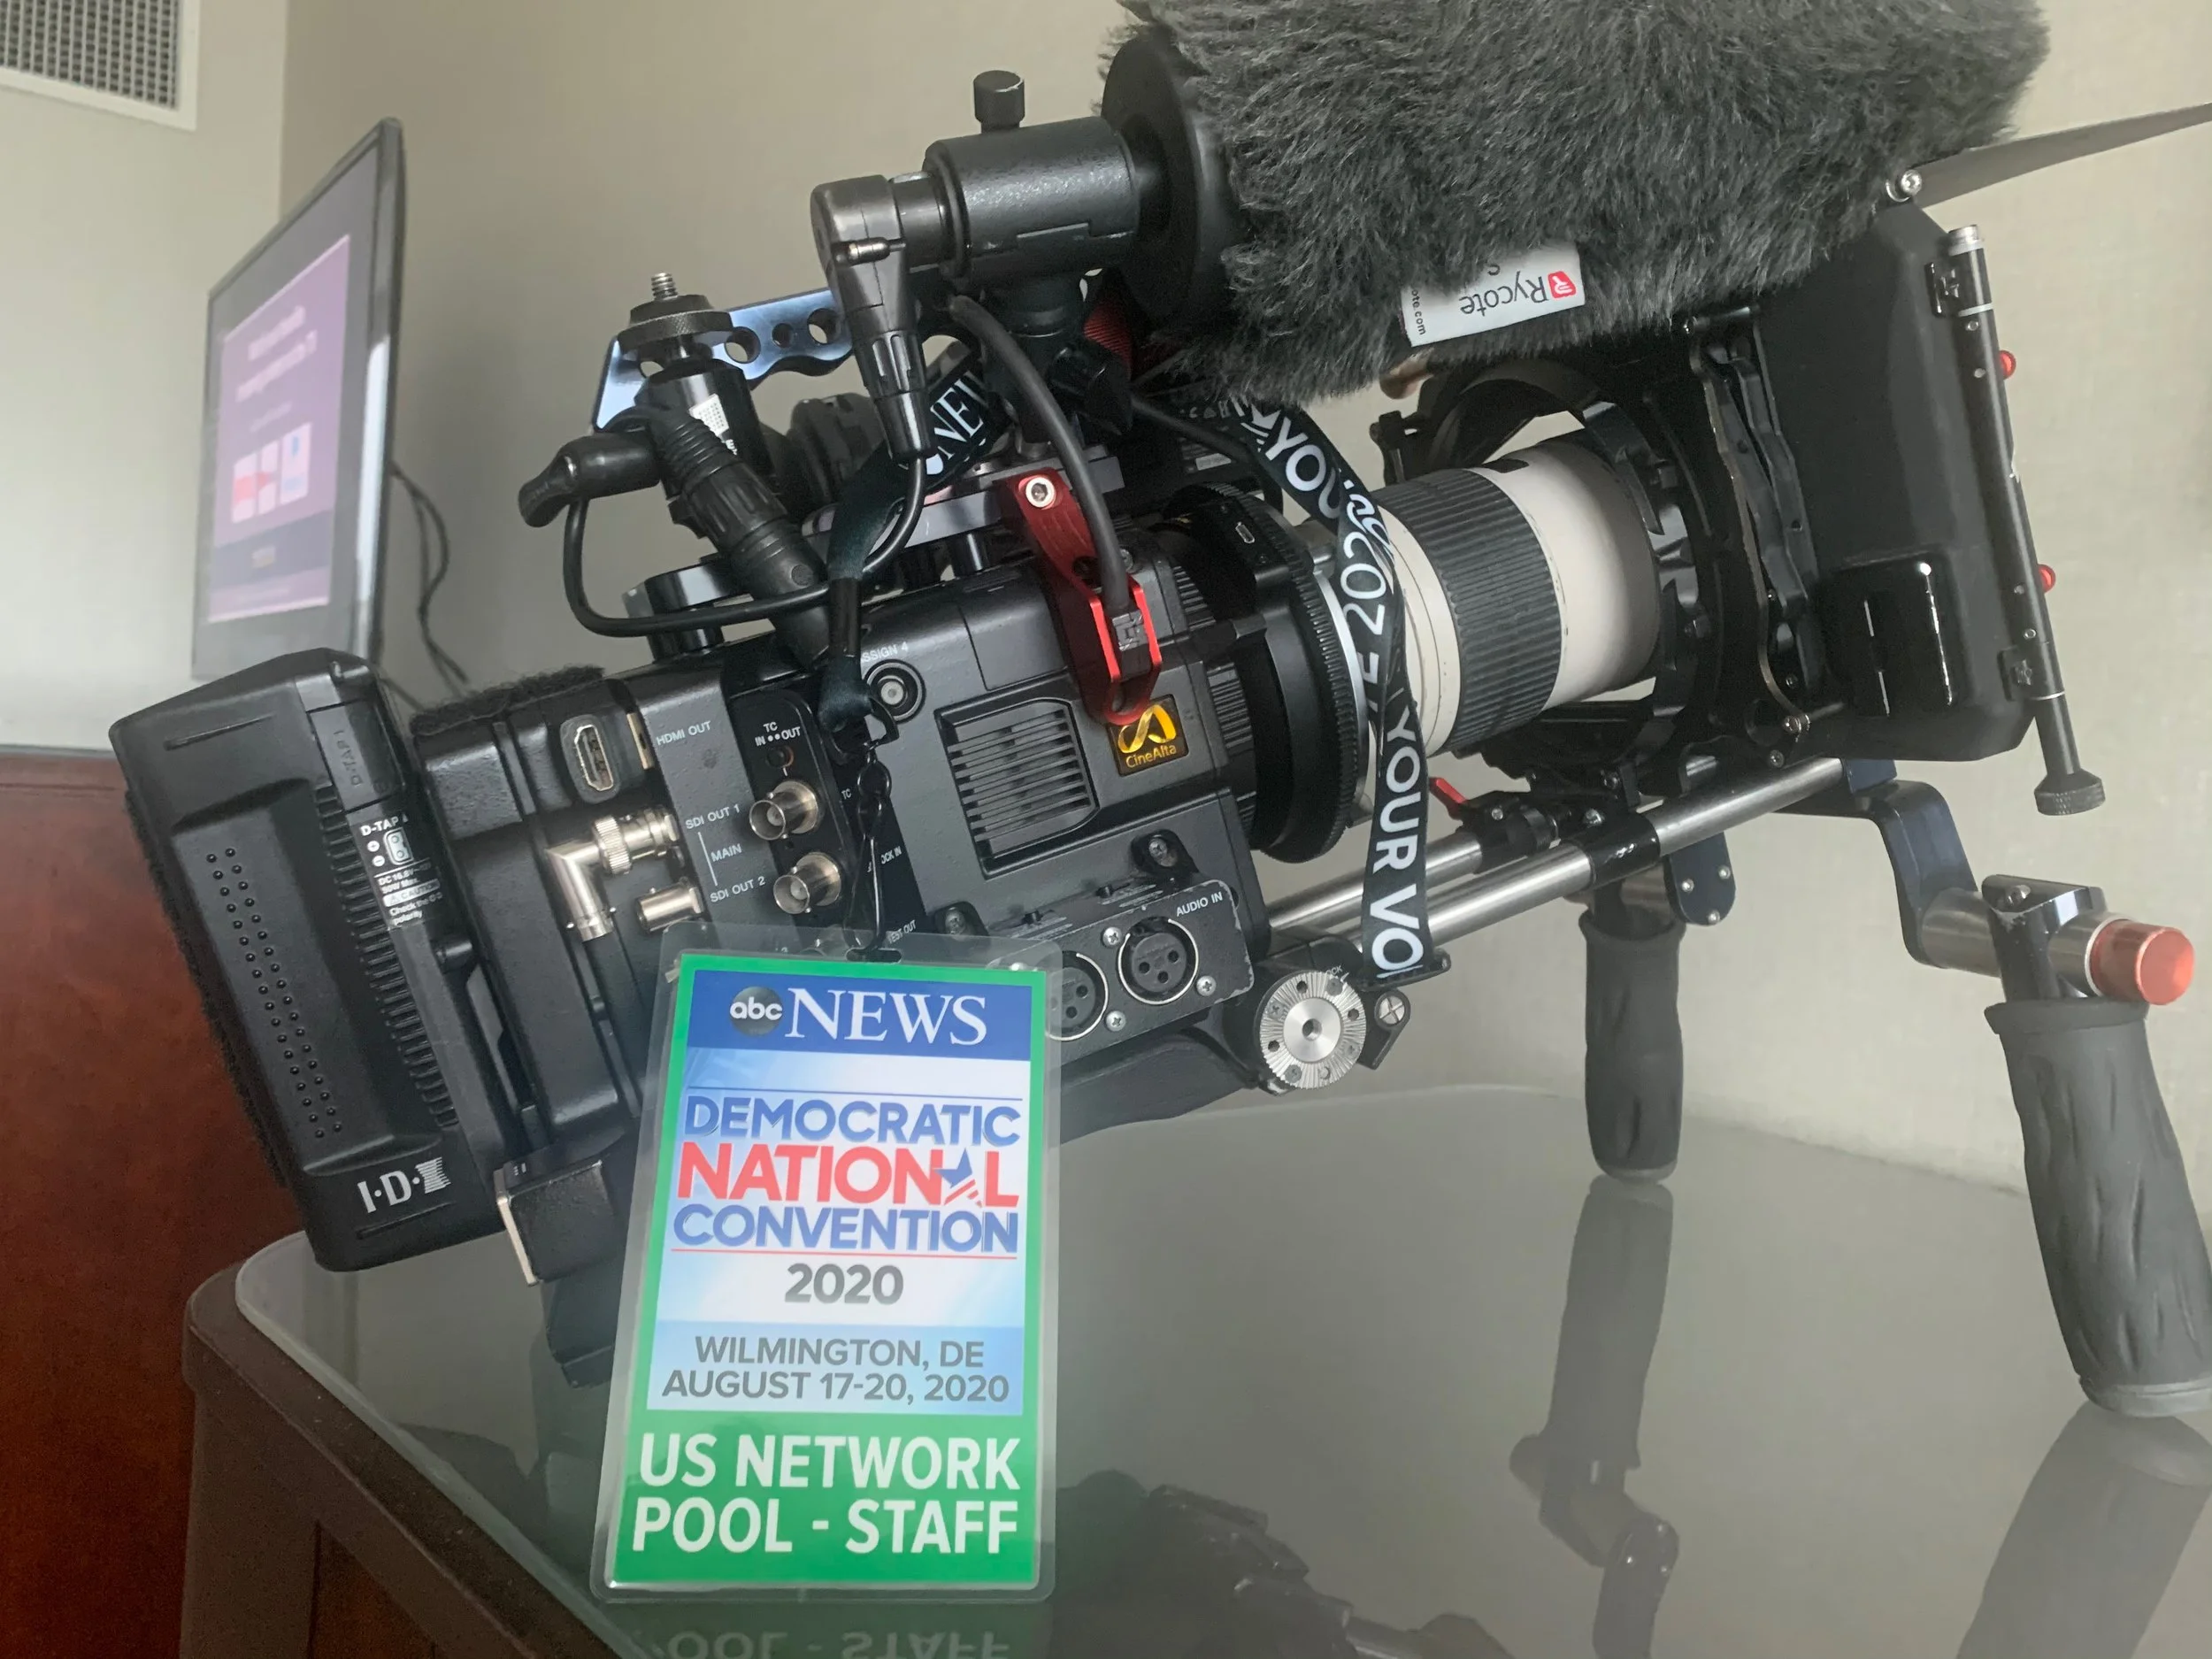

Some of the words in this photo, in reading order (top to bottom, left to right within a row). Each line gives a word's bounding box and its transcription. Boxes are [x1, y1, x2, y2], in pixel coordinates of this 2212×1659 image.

[1459, 270, 1549, 317] Rycote
[860, 643, 898, 664] SSIGN
[901, 641, 909, 653] 4
[656, 729, 686, 747] HDMI
[687, 720, 712, 735] OUT
[755, 735, 766, 747] IN
[781, 726, 802, 741] OUT
[763, 721, 778, 733] TC
[1125, 744, 1177, 768] CineAlta
[1372, 705, 1421, 874] YOUR
[360, 816, 399, 836] D-TAP
[685, 816, 705, 830] SDI
[707, 807, 731, 823] OUT
[733, 803, 741, 813] 1
[710, 843, 742, 863] MAIN
[710, 888, 729, 903] SDI
[732, 880, 755, 895] OUT
[757, 876, 766, 886] 2
[1176, 897, 1209, 918] AUDIO
[1210, 891, 1224, 904] IN
[903, 919, 917, 934] OUT
[1370, 883, 1424, 979] VO
[730, 998, 783, 1021] abc
[785, 987, 987, 1045] NEWS
[684, 1094, 1021, 1147] DEMOCRATIC
[677, 1141, 1019, 1208] NATIONAL
[673, 1202, 1018, 1254] CONVENTION
[785, 1263, 903, 1305] 2020
[695, 1336, 929, 1371] WILMINGTON,
[939, 1340, 985, 1368] DE
[662, 1370, 810, 1399] AUGUST
[819, 1373, 914, 1404] 17-20,
[924, 1374, 1010, 1402] 2020
[640, 1432, 718, 1488] US
[735, 1434, 1021, 1490] NETWORK
[633, 1496, 793, 1553] POOL
[812, 1520, 829, 1530] -
[845, 1499, 1018, 1554] STAFF
